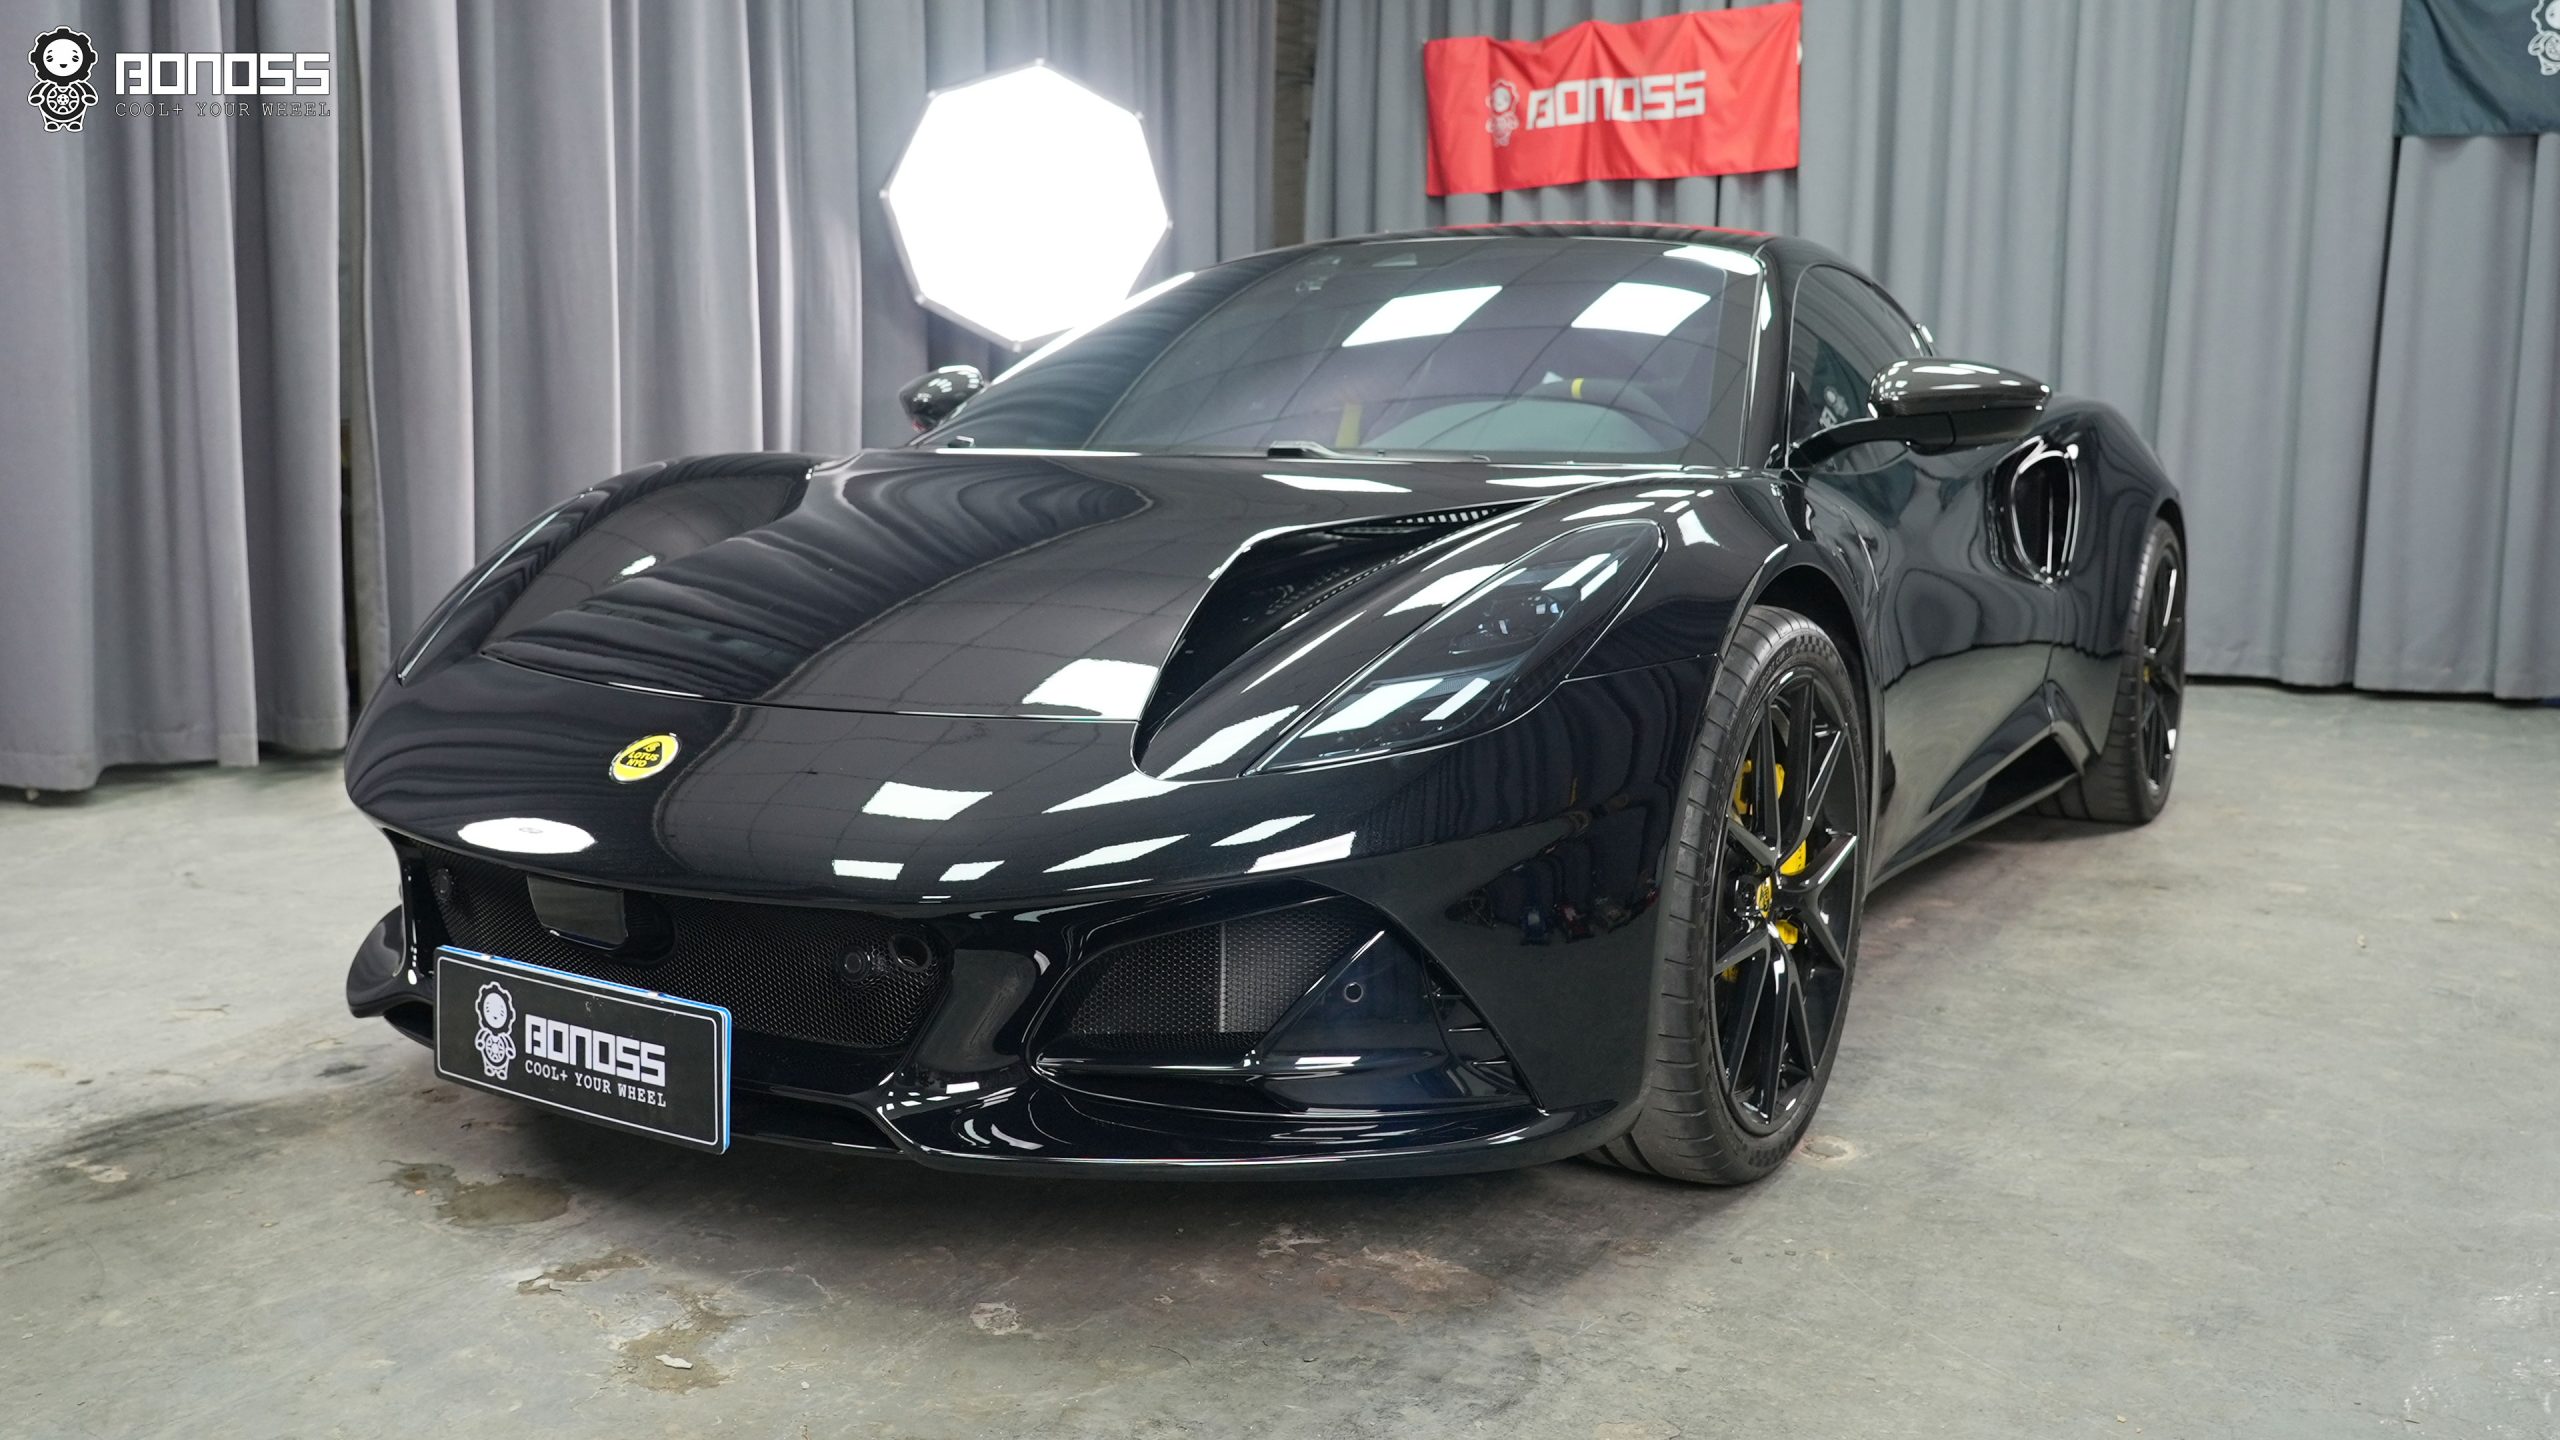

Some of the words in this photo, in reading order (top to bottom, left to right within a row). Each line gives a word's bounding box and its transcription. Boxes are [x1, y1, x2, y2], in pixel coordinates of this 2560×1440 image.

[1527, 70, 1706, 130] BONOSS
[628, 751, 659, 762] LOTUS
[525, 1013, 666, 1087] BONOSS
[525, 1059, 568, 1082] COOL+
[574, 1071, 612, 1095] YOUR
[617, 1083, 667, 1108] WHEEL
